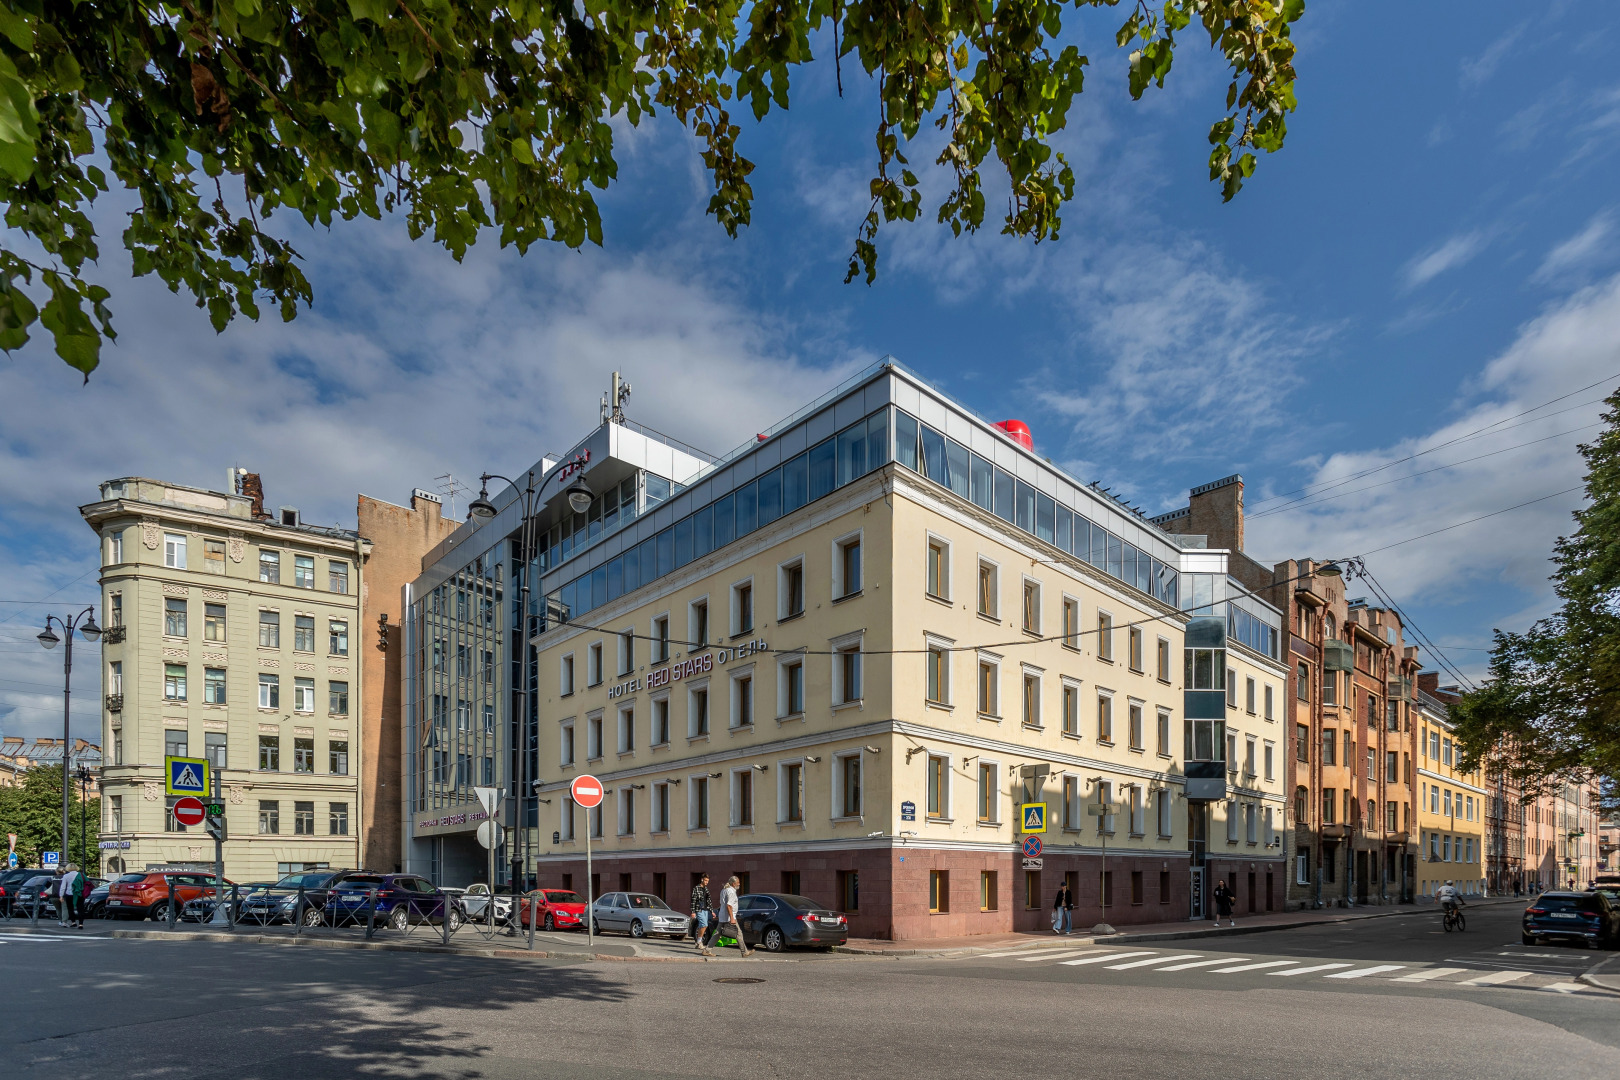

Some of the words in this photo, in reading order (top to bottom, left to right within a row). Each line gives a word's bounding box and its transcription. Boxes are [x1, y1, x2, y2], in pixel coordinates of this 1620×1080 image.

[608, 678, 643, 699] HOTEL
[646, 667, 670, 689] RED
[673, 654, 713, 680] STARS
[717, 638, 768, 664] ОТЕЛЬ
[440, 816, 450, 826] RED
[450, 813, 466, 825] STARS
